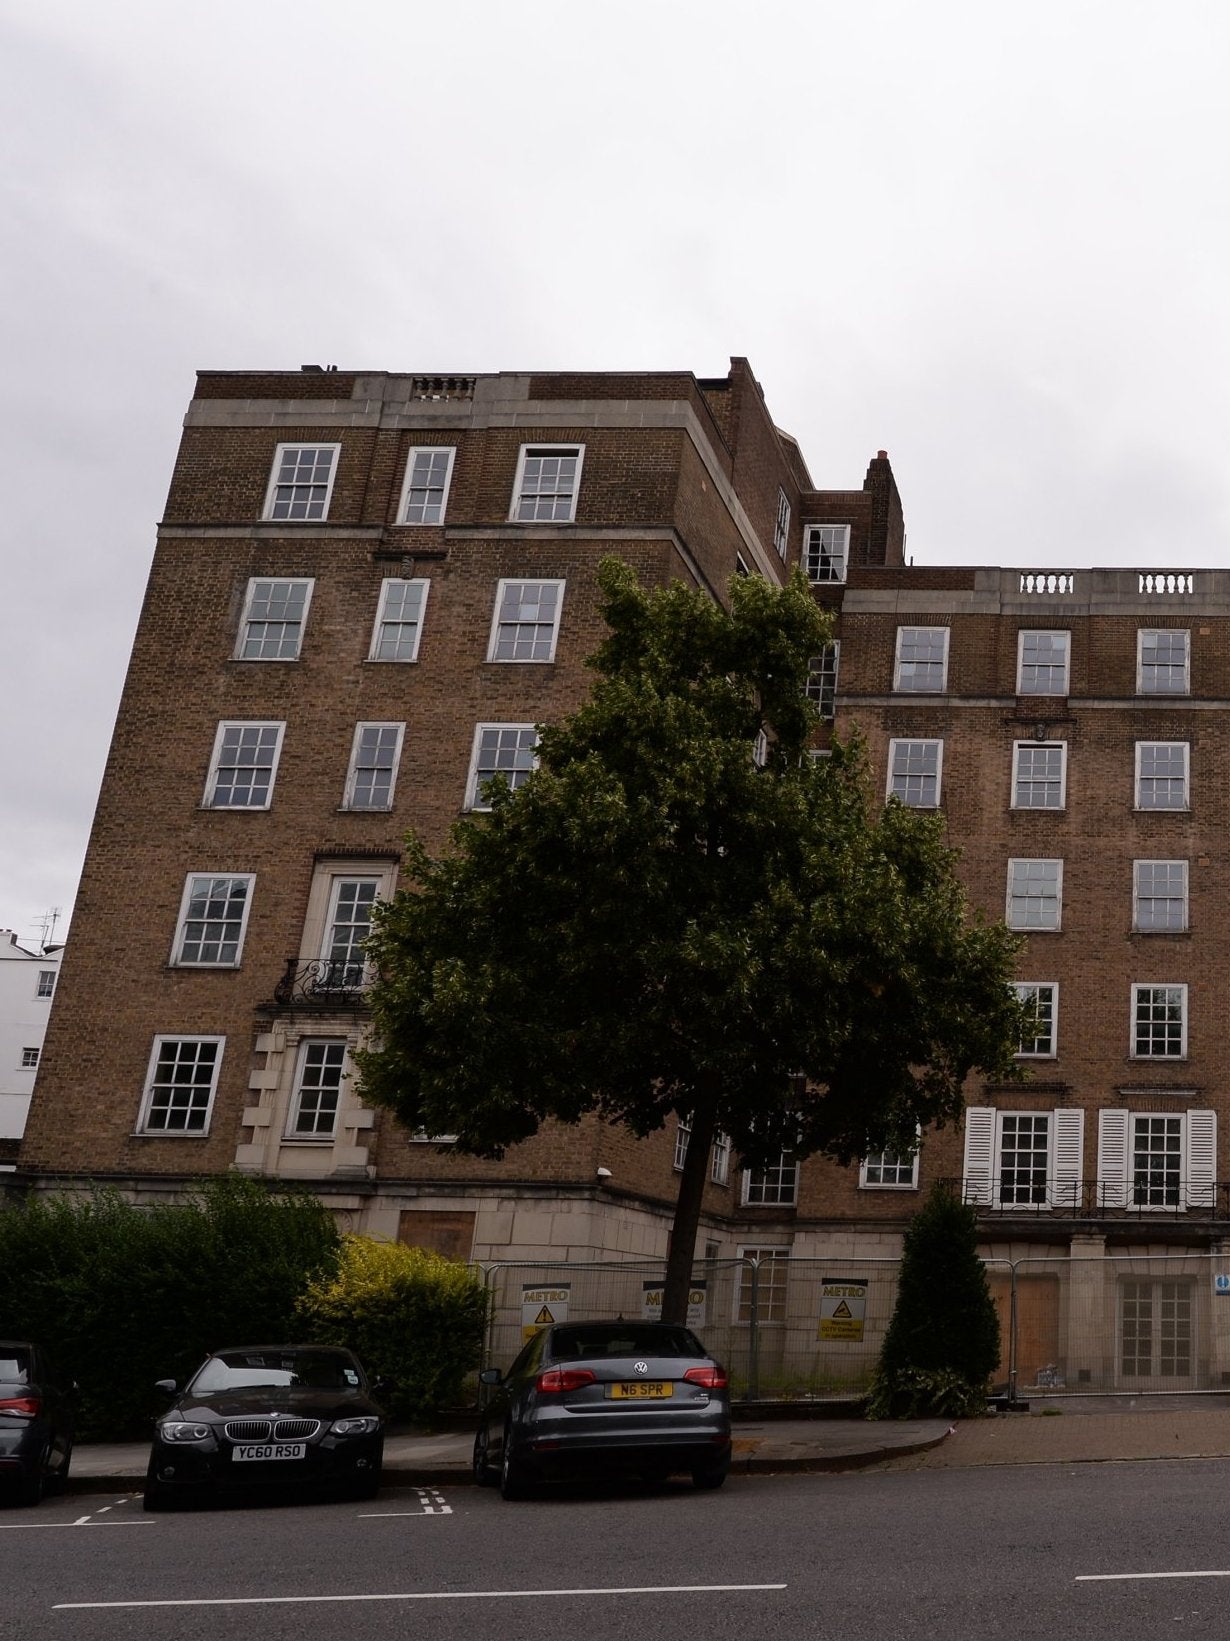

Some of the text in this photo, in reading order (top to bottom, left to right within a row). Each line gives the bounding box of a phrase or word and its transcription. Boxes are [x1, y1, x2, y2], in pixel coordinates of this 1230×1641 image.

[524, 1291, 568, 1302] METRO
[824, 1286, 865, 1297] METRO
[621, 1384, 663, 1395] N6 SPR
[239, 1447, 272, 1459] YC60
